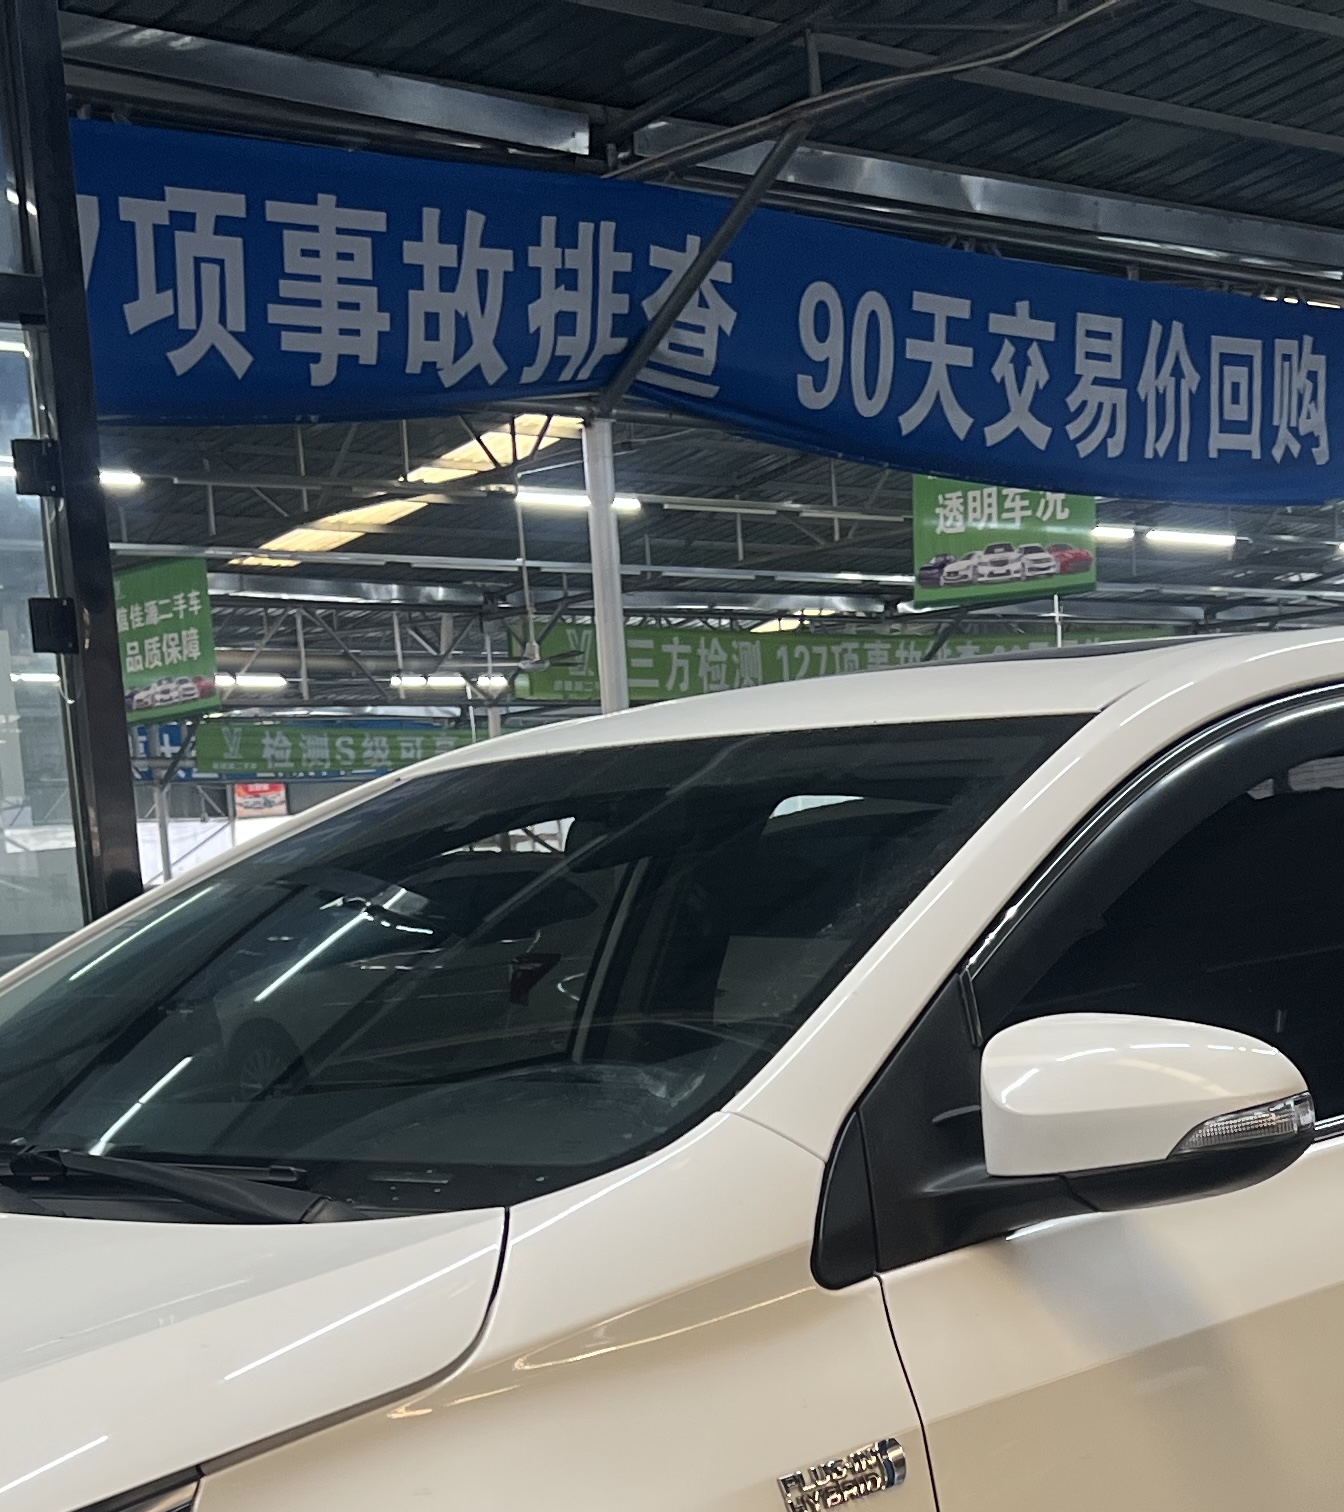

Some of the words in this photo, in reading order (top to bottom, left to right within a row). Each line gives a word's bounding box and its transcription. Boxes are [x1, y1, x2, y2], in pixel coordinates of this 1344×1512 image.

[796, 280, 1330, 465] 90天交易价回购
[125, 626, 202, 673] 品质保障
